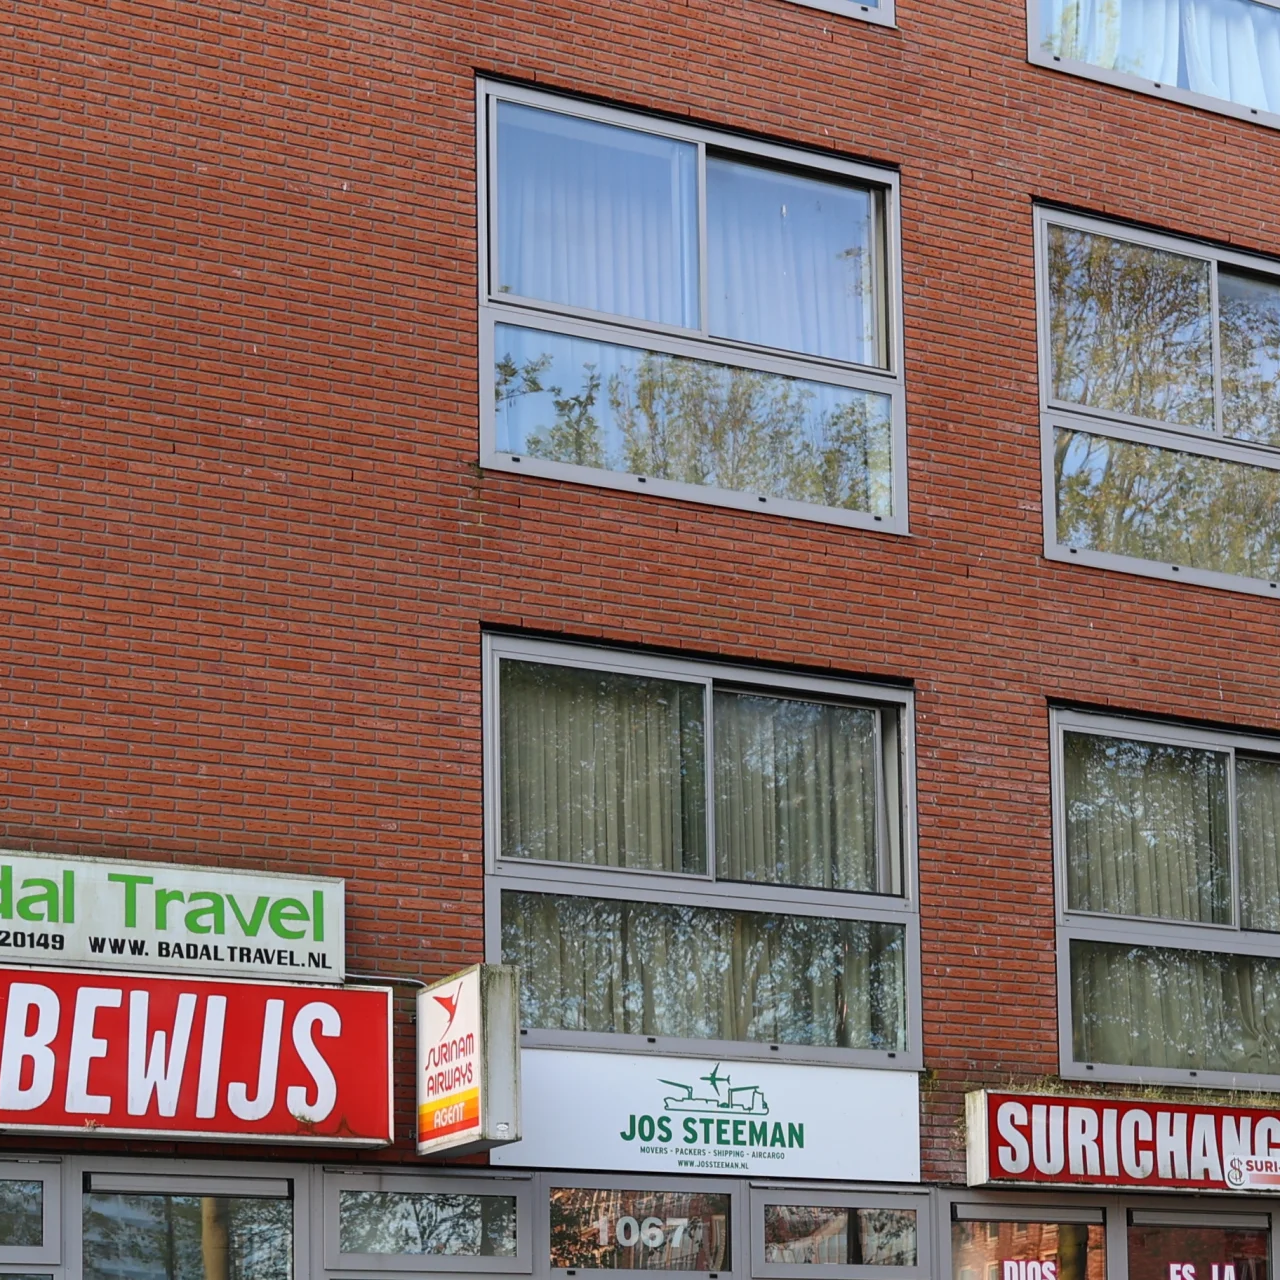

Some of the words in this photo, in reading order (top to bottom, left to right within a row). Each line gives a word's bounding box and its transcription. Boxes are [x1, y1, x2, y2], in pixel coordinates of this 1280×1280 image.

[107, 872, 324, 942] Travel
[424, 1032, 475, 1071] SURINAM
[426, 1061, 473, 1097] AIRWAYS
[433, 1101, 466, 1129] AGENT
[620, 1114, 673, 1143] JOS
[682, 1116, 805, 1149] STEEMAN
[639, 1146, 669, 1155] MOVERS
[674, 1148, 706, 1157] PACKERS
[712, 1150, 745, 1158] SHIPPING
[751, 1151, 786, 1160] AIRCARGO
[677, 1159, 749, 1170] WWW.JOSSTEEMAN.NL
[592, 1215, 689, 1248] 1067
